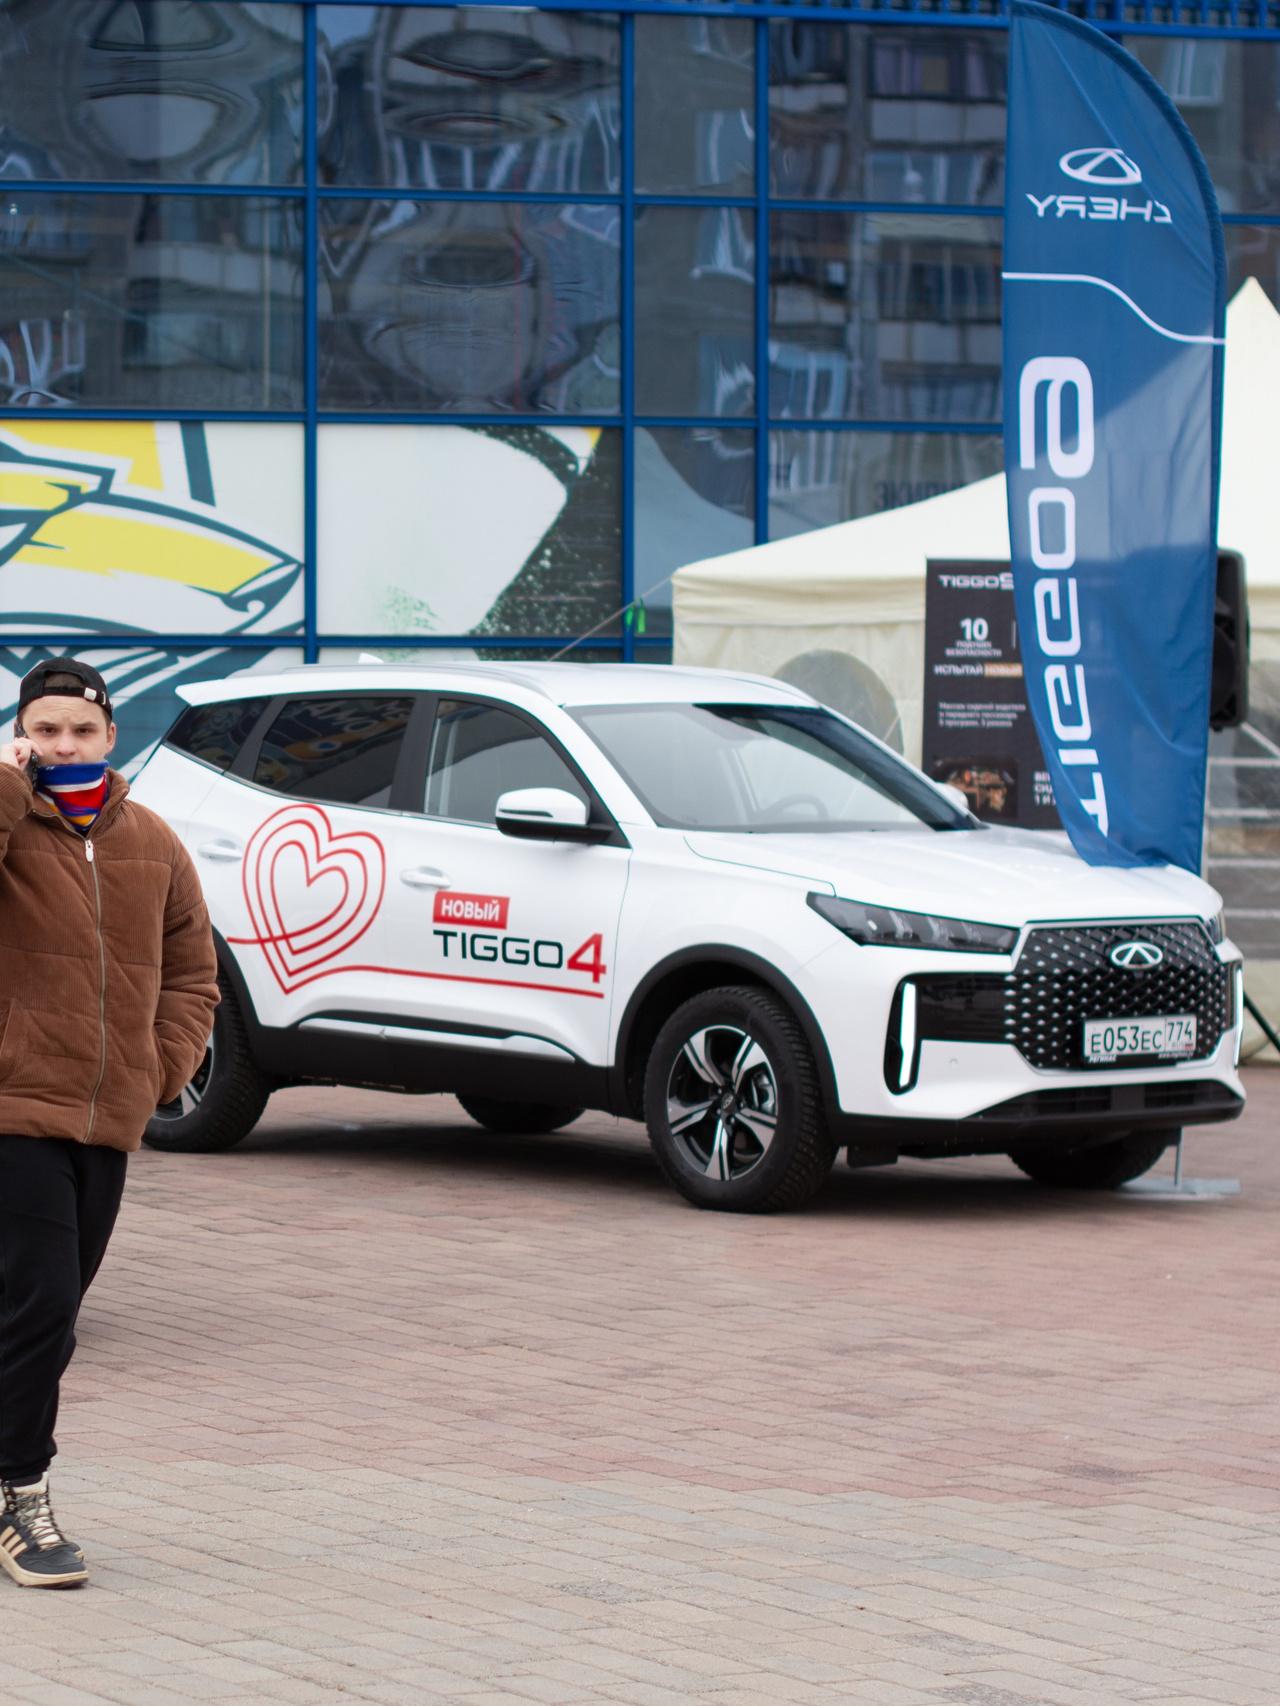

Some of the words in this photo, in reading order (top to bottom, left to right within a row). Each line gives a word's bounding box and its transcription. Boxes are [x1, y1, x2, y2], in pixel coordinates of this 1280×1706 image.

[960, 617, 989, 641] 10
[934, 663, 983, 676] ИСПЫТАЙ
[441, 899, 500, 922] НОВЫЙ
